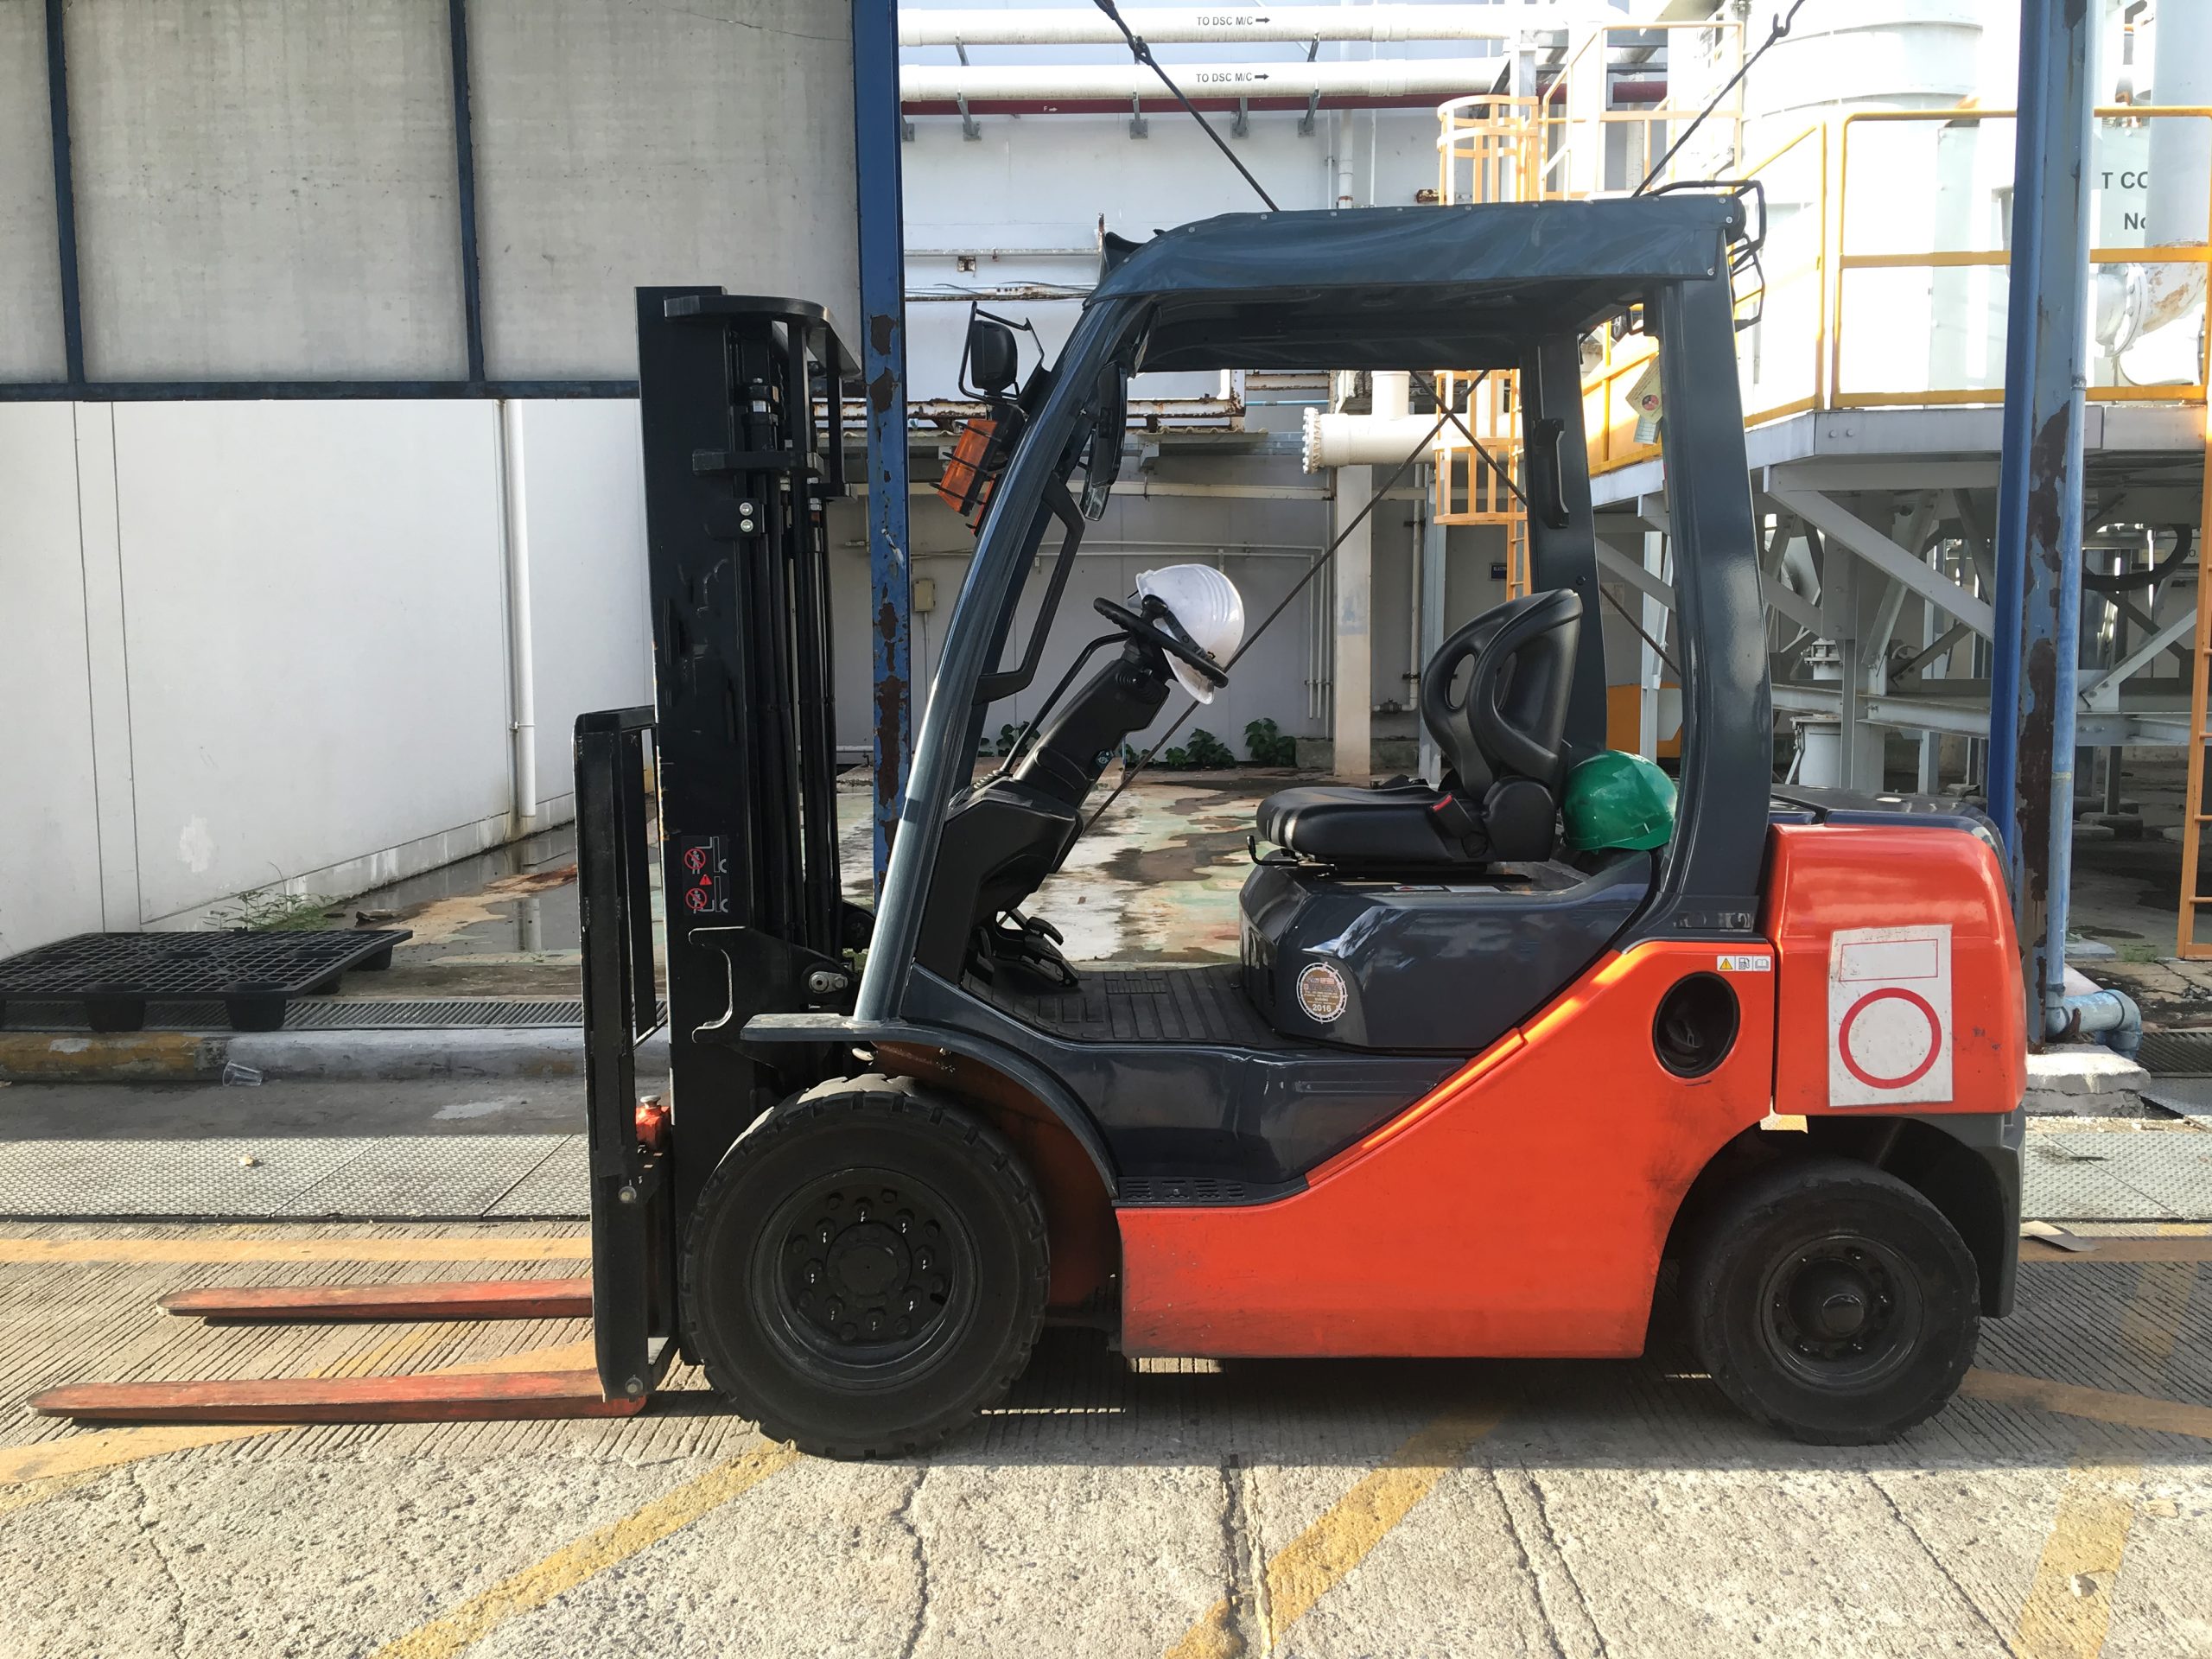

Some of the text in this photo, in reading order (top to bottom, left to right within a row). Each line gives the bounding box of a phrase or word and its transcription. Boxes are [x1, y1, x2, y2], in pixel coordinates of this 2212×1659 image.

[1197, 16, 1253, 26] TO DSC M/C
[1196, 72, 1252, 83] TO DSC M/C
[2101, 172, 2113, 189] T
